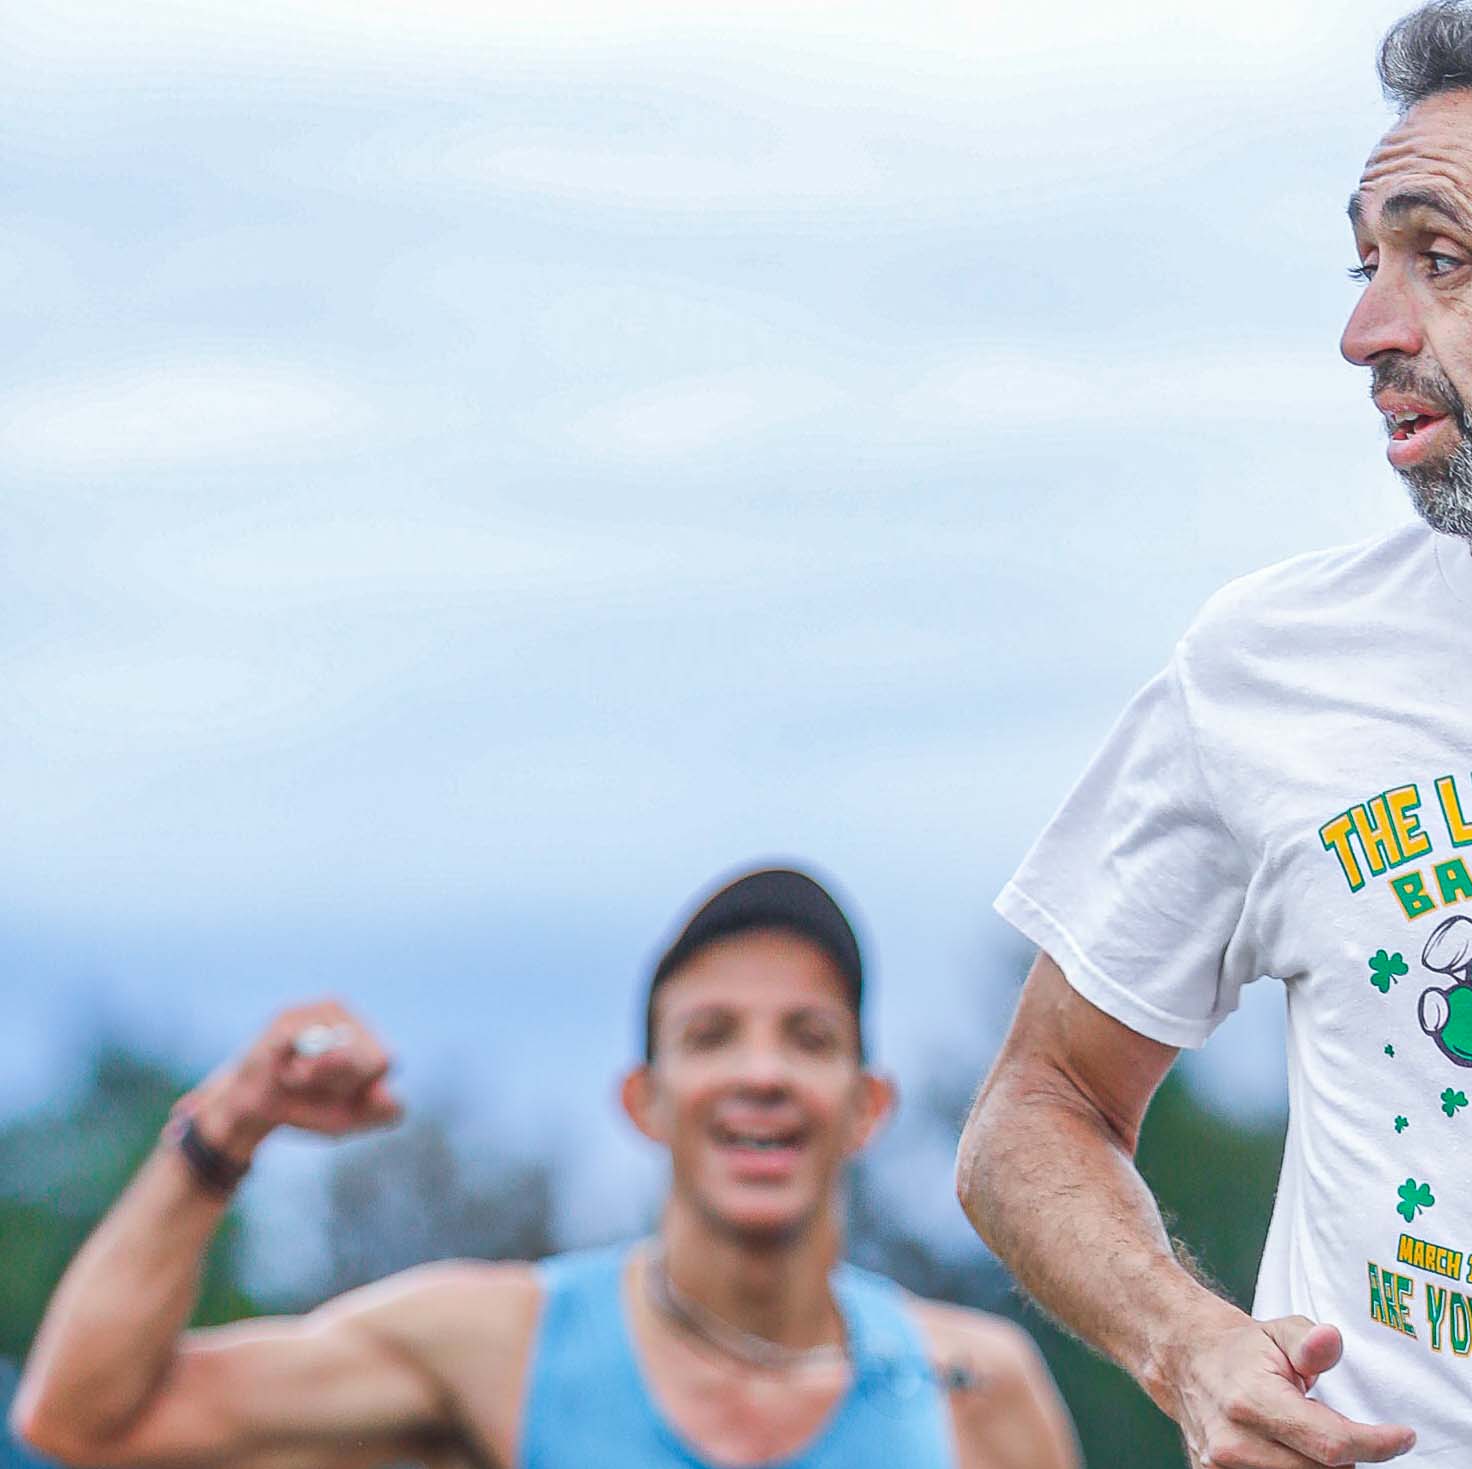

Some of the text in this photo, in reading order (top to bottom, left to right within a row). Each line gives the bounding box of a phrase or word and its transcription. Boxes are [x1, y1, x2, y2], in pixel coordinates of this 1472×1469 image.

[1320, 784, 1433, 893] THE
[1397, 1233, 1463, 1280] MARCH
[1367, 1260, 1418, 1340] ARE
